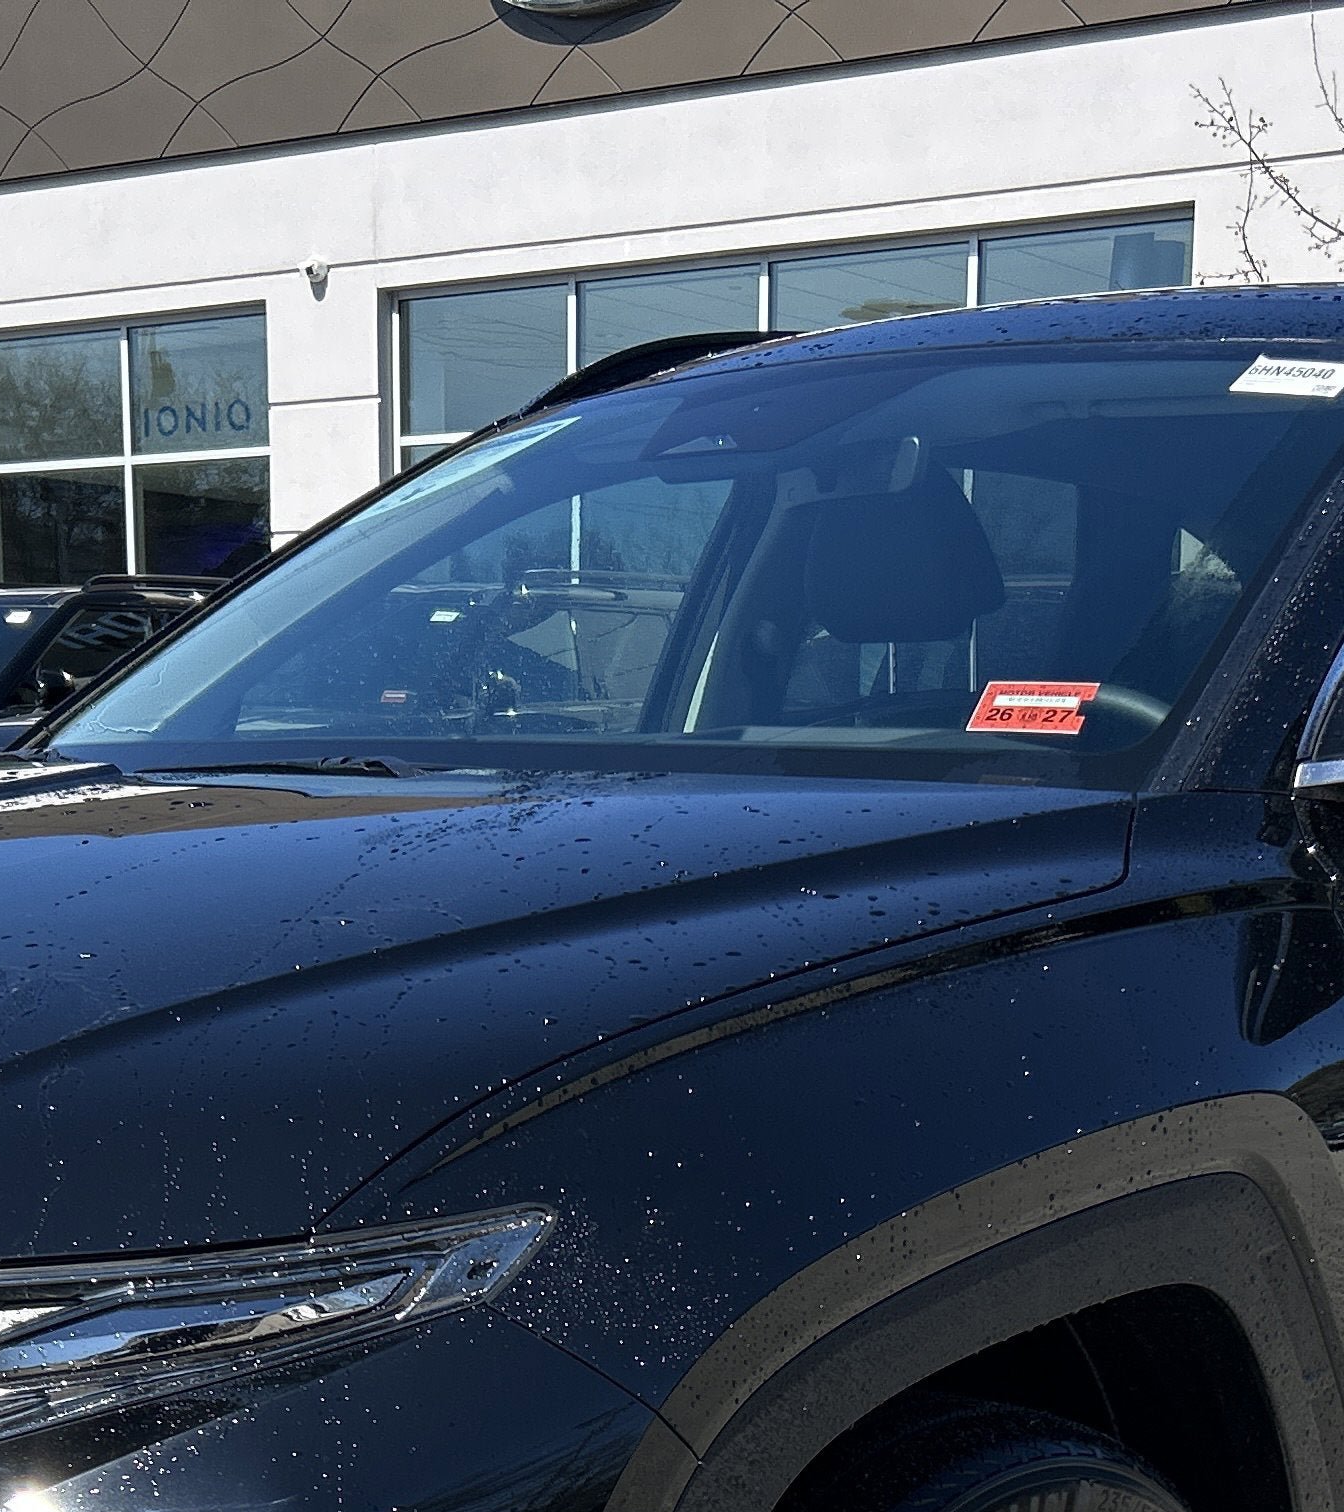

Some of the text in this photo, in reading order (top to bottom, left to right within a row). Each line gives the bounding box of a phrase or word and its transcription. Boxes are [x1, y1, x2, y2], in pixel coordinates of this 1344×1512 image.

[1248, 365, 1336, 379] 6HN45040
[143, 399, 251, 438] IONIQ
[985, 708, 1015, 722] 26
[1042, 709, 1076, 723] 27
